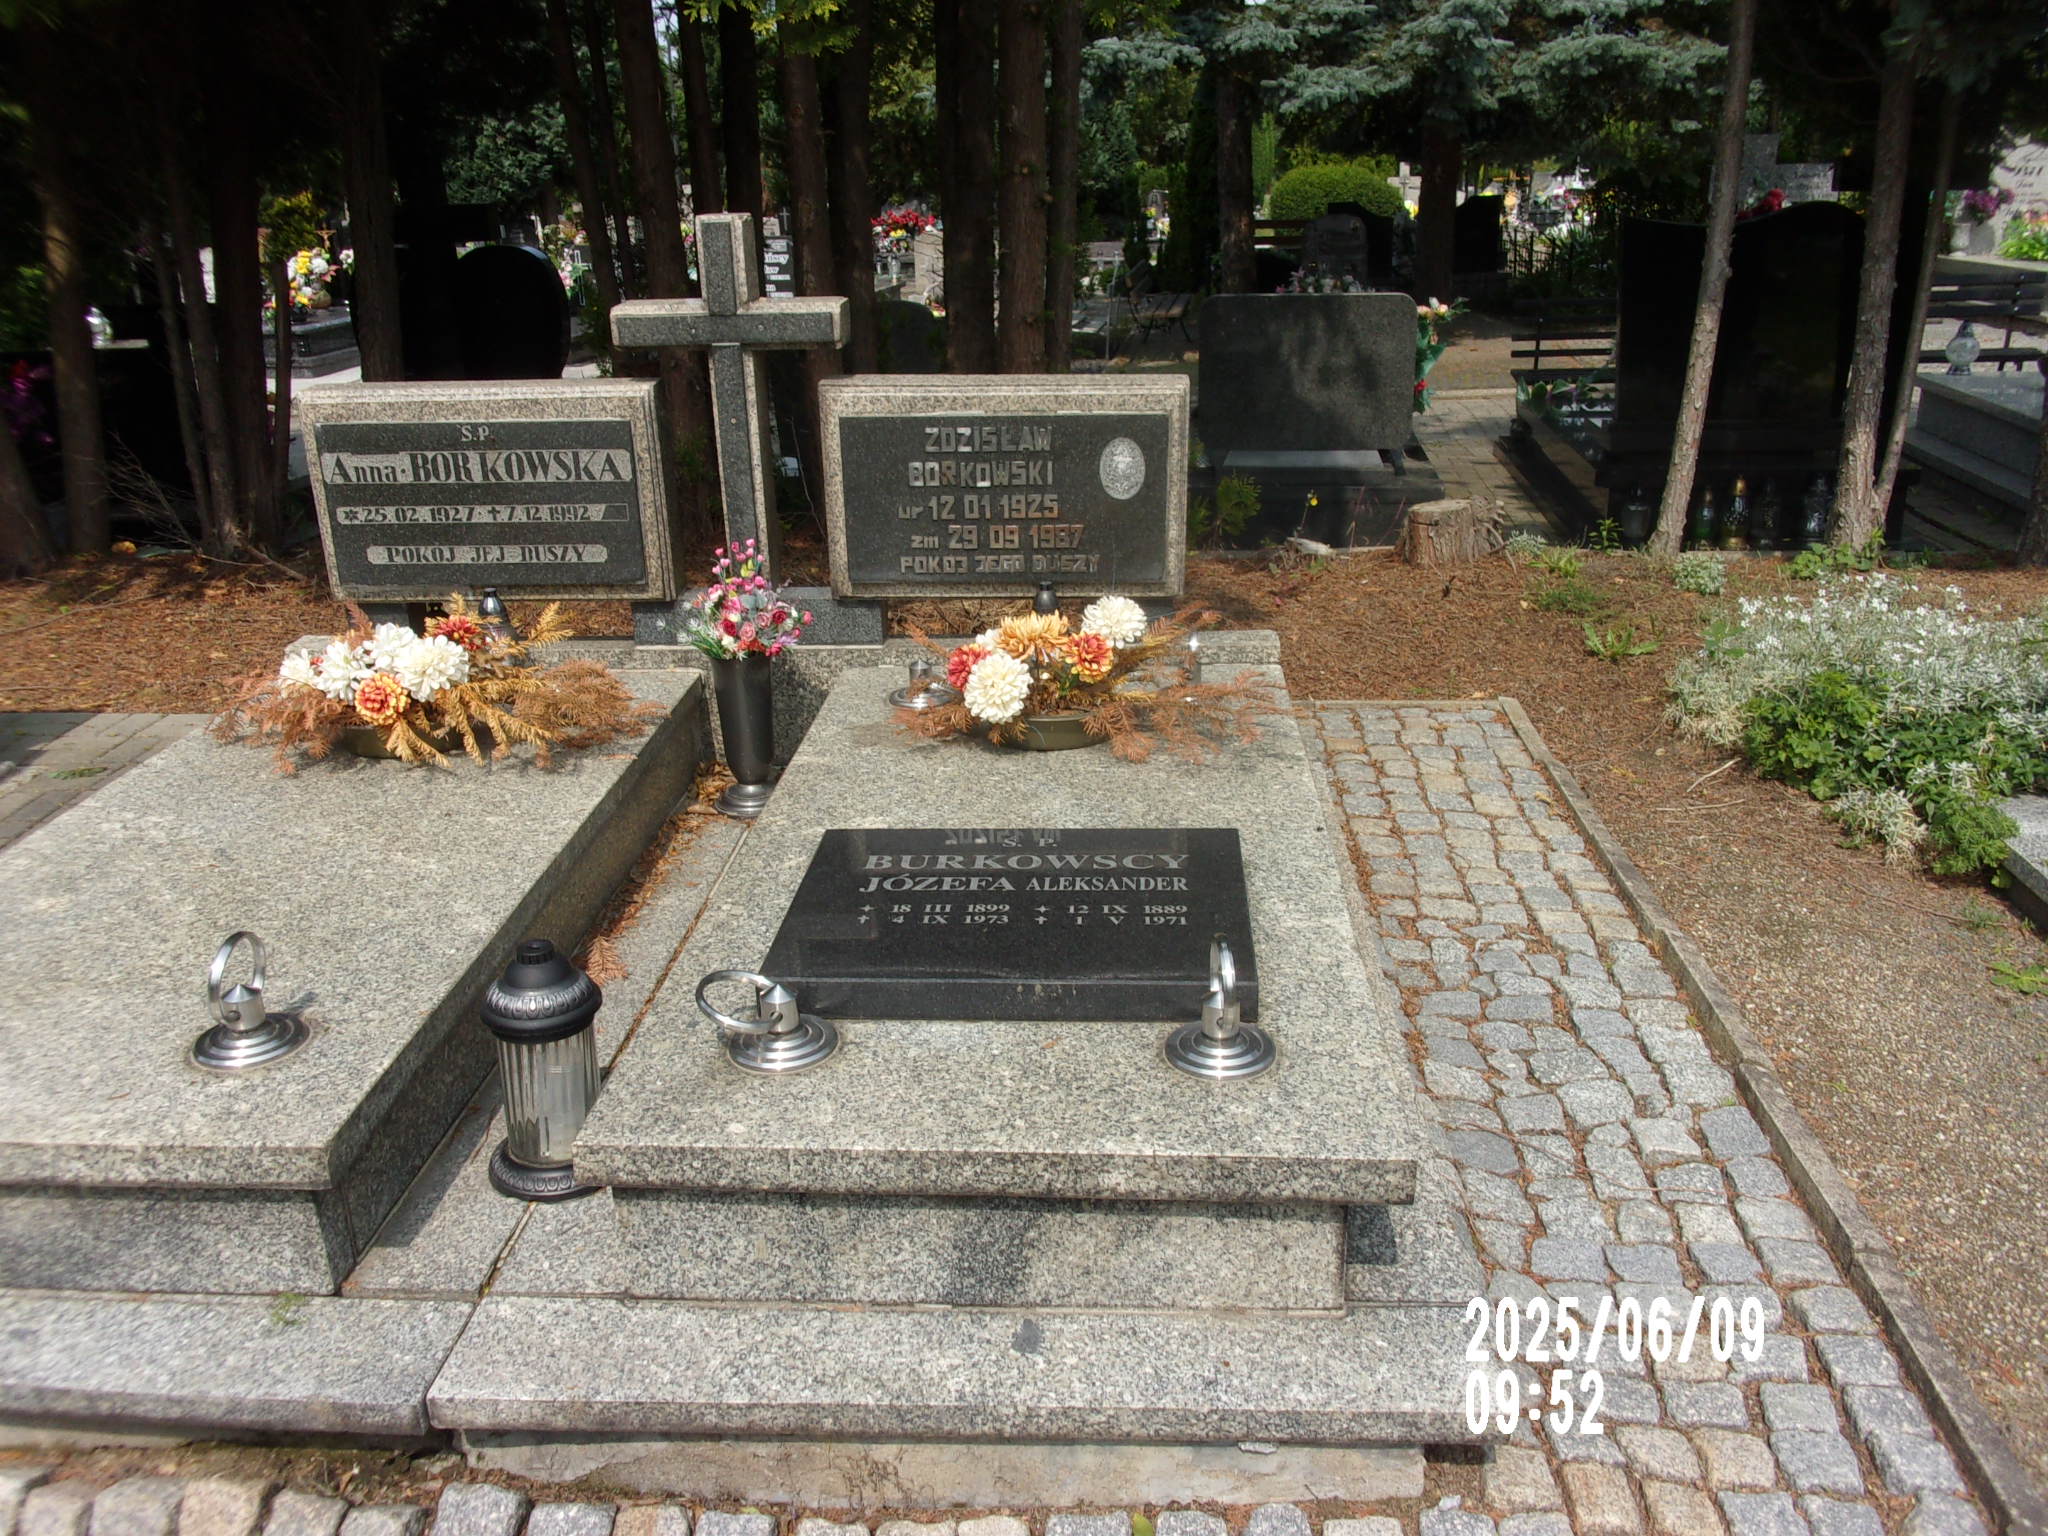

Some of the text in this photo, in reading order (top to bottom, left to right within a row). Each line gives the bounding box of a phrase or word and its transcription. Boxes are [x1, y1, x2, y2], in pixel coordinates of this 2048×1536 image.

[330, 451, 623, 484] Anna BORKOWSKA
[908, 461, 1053, 487] BORKOWSKI
[928, 496, 955, 520] 12
[964, 494, 991, 519] 01
[999, 494, 1059, 519] 1925
[911, 524, 1085, 549] zm 29 09 1987
[470, 546, 505, 562] JEJ
[520, 545, 587, 562] DUSZY
[975, 555, 1025, 573] JEGO
[1033, 555, 1100, 573] DUSZY
[863, 855, 1190, 870] BURKOWSCY
[859, 873, 1189, 892] JÓZEFA ALEKSANDER
[892, 903, 1188, 914] 18 III 1899 12 IX 1889
[922, 915, 948, 925] IX
[964, 915, 1009, 925] 1973
[1108, 915, 1124, 925] V
[1144, 915, 1188, 925] 1971
